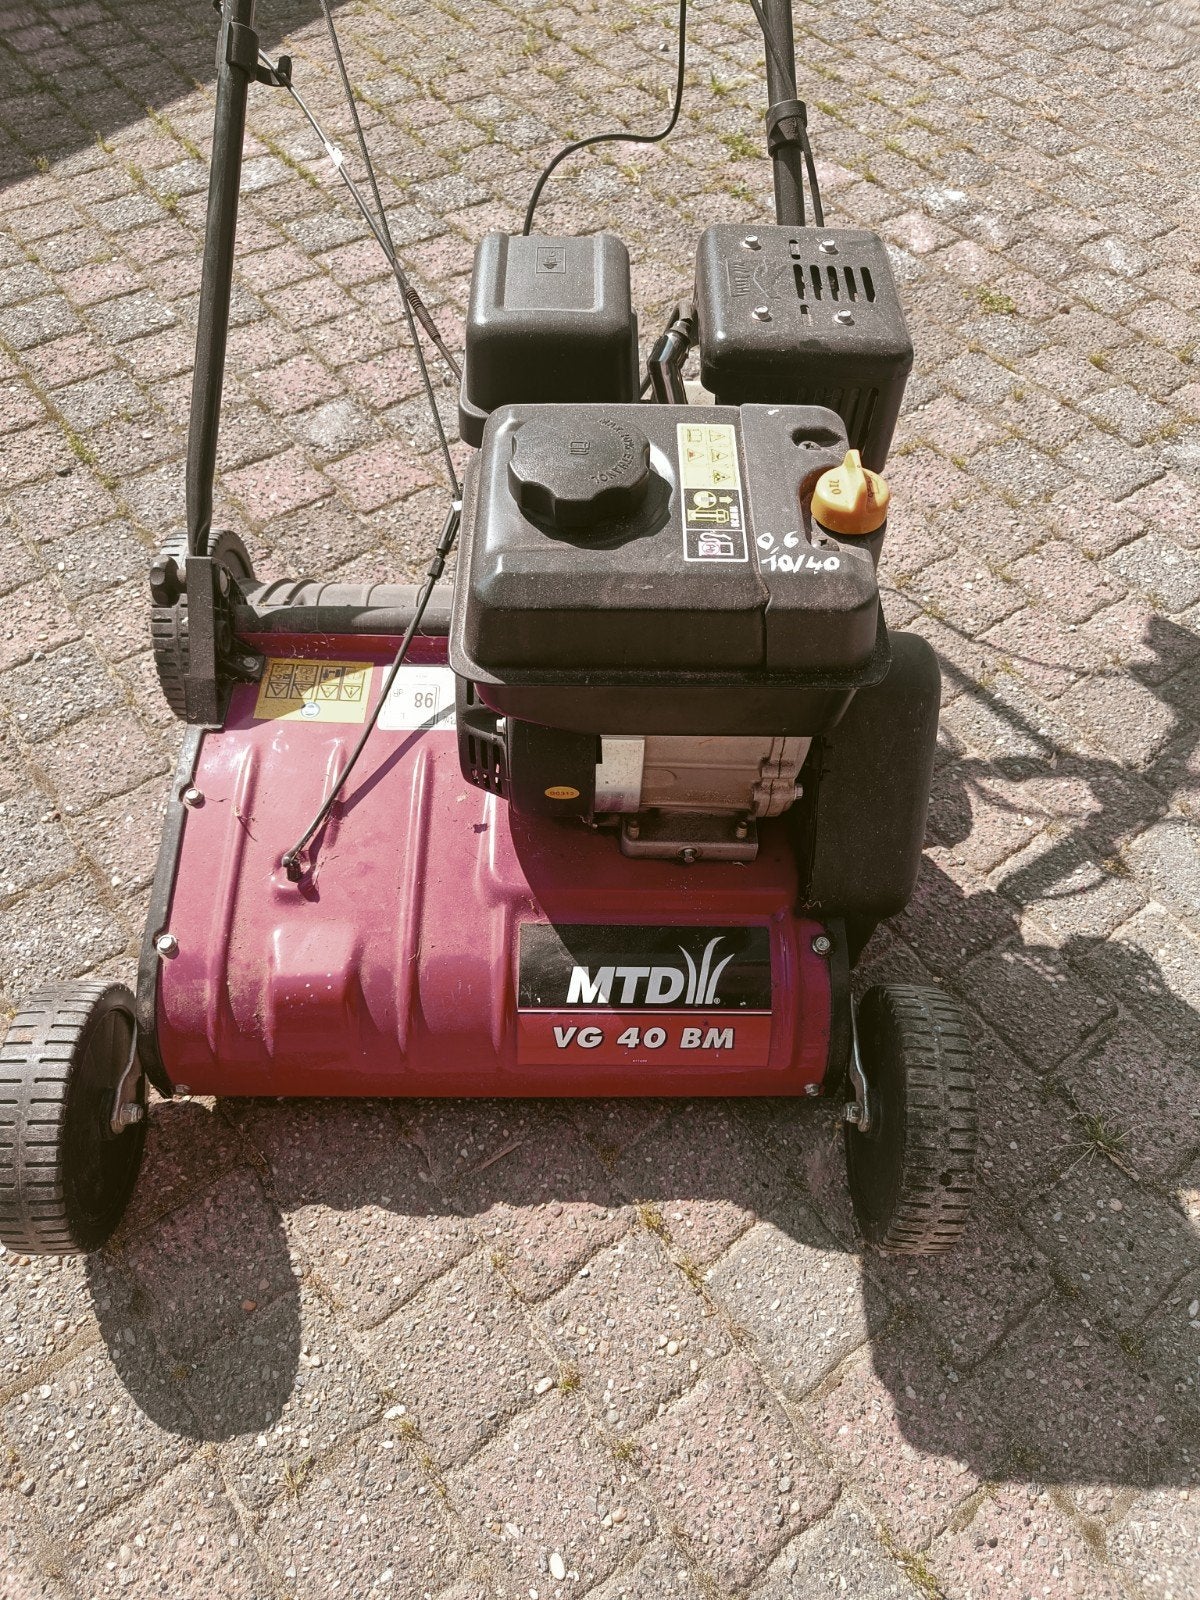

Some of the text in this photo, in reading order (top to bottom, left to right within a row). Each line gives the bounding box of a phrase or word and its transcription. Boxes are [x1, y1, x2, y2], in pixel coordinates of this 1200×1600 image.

[590, 453, 634, 484] ETHANOL
[829, 479, 842, 495] OIL
[760, 553, 840, 574] 10/40
[566, 966, 685, 1004] MTD
[553, 1026, 734, 1049] VG 40 BM
